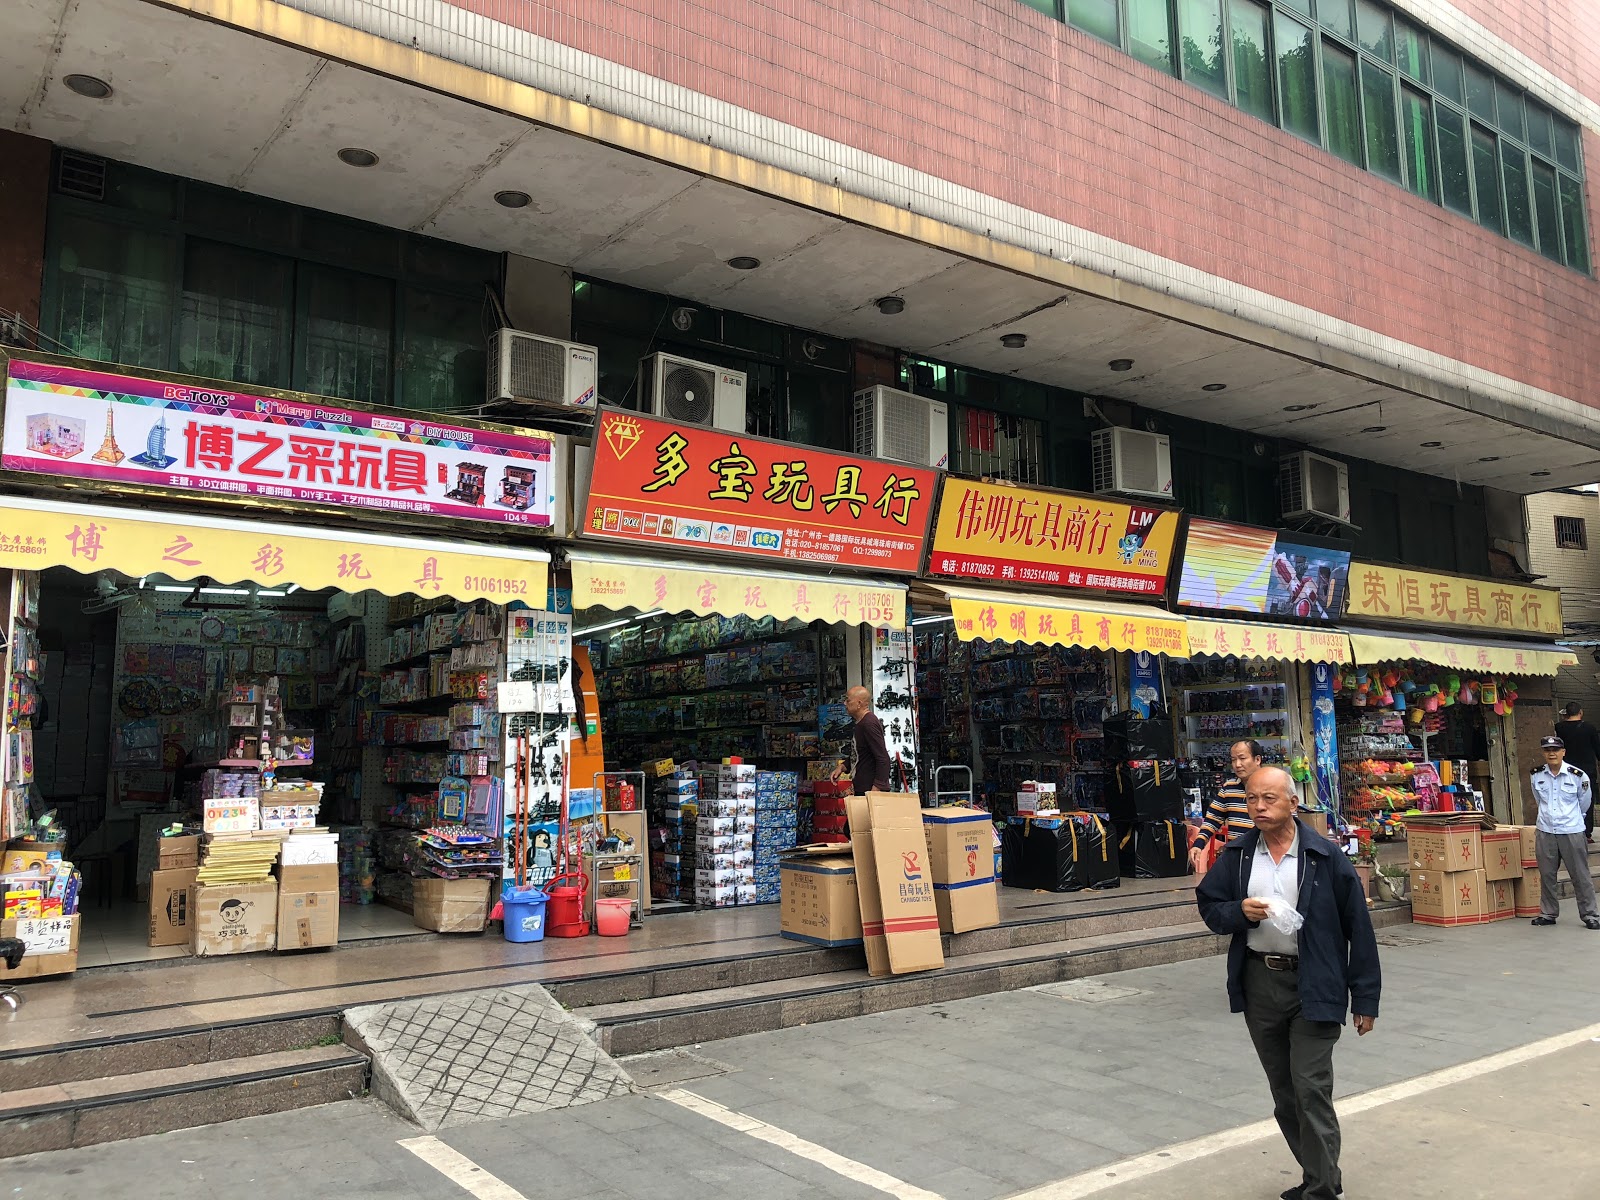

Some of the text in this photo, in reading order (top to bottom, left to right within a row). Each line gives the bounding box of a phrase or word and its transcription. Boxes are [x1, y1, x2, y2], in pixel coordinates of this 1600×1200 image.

[277, 403, 352, 423] Merry Puzzle
[427, 427, 474, 442] DIY HOUSE
[641, 432, 920, 525] 多宝玩具行
[504, 513, 528, 523] 1D4号
[592, 507, 603, 530] 代理
[663, 522, 672, 531] IQ
[955, 488, 1114, 555] 伟明玩具商行
[1130, 510, 1154, 527] LM
[65, 523, 444, 591] 博之彩玩具
[1142, 549, 1158, 558] WEI
[1138, 558, 1158, 568] MING
[464, 575, 527, 595] 81061952
[650, 574, 851, 617] 多宝玩具行
[858, 592, 895, 608] 81857061
[1362, 570, 1542, 628] 荣恒玩具商行
[858, 607, 894, 621] 1D5
[979, 606, 1137, 646] 伟明玩具商行
[1145, 625, 1181, 638] 81870852
[1213, 626, 1306, 660] 悠点玩具
[526, 866, 564, 880] POLICE
[899, 882, 931, 897] 昌奇玩具
